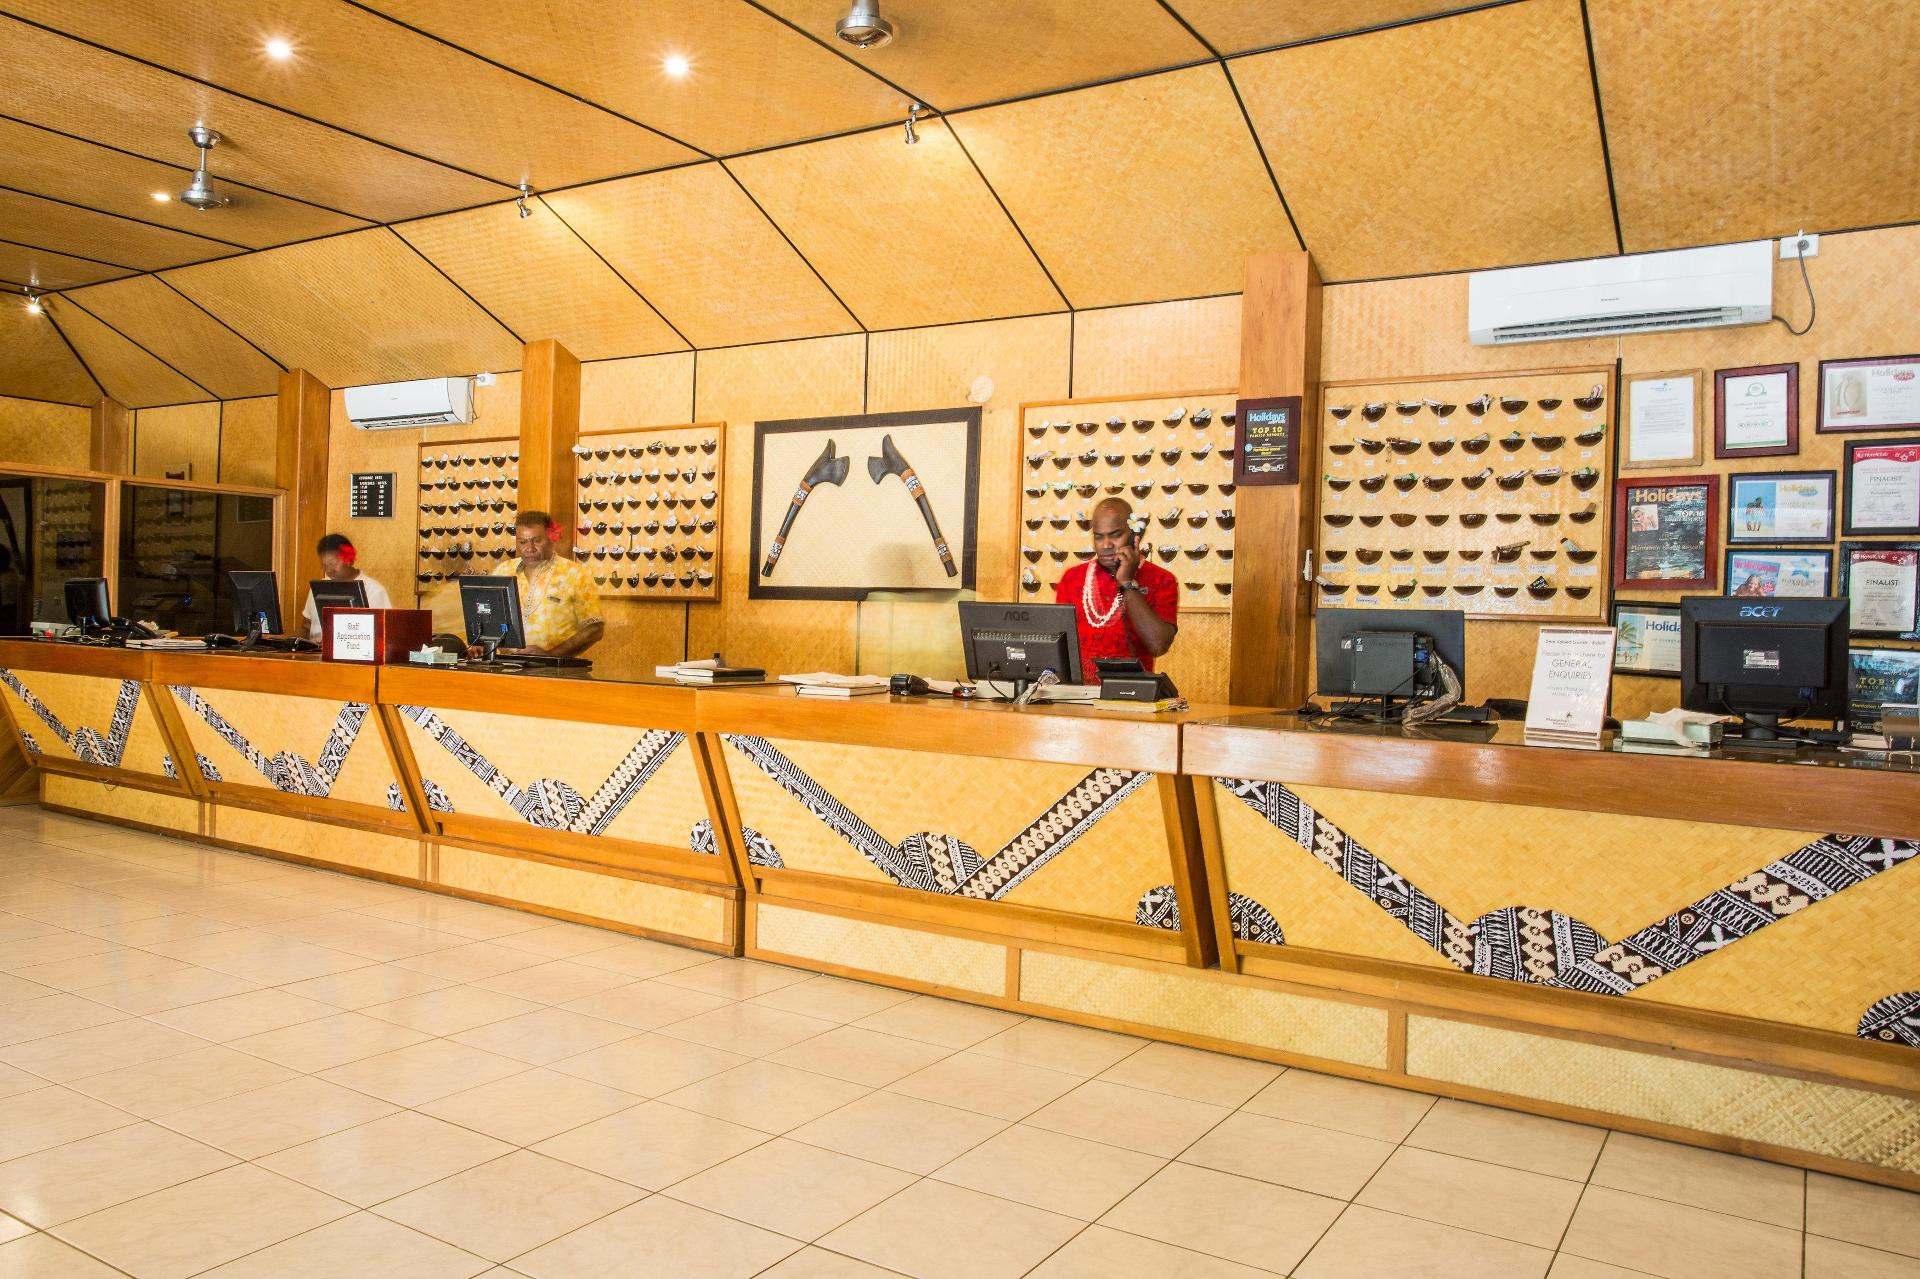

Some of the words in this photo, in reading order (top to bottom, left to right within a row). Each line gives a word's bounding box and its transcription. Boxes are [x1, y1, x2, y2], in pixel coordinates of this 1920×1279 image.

[1249, 411, 1286, 422] Holidays
[1635, 488, 1702, 502] Holidays
[1866, 579, 1899, 587] FINALIST
[1004, 611, 1030, 621] AOC
[1740, 606, 1784, 618] acer
[347, 622, 360, 630] Staff
[337, 632, 371, 642] Appreciation
[346, 642, 360, 650] Fund
[1551, 659, 1592, 669] GENERAL
[1548, 670, 1592, 680] ENQUIRIES
[1860, 677, 1885, 686] TOP
